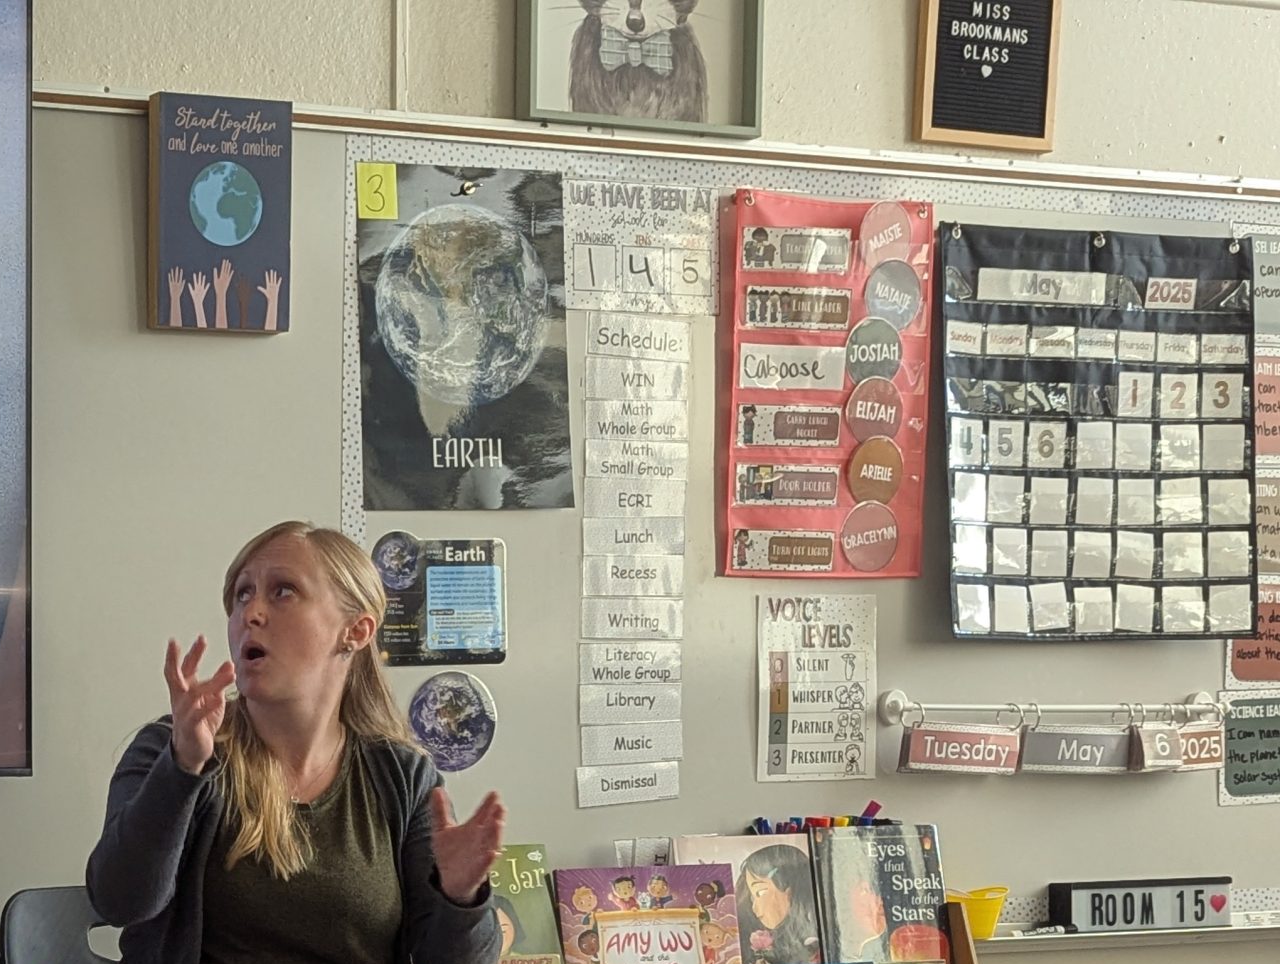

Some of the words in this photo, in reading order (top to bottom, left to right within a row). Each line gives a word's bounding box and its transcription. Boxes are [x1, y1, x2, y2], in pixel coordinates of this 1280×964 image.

[972, 1, 1011, 20] MISS
[951, 20, 1029, 45] BROOKMANS
[963, 44, 1009, 63] CLASS
[175, 106, 220, 130] Stand
[220, 110, 276, 141] together
[167, 132, 187, 151] and
[190, 132, 220, 155] love
[220, 140, 239, 155] one
[242, 137, 284, 158] another
[365, 173, 386, 213] 3
[569, 182, 596, 207] WE
[601, 183, 644, 210] HAVE
[650, 185, 688, 213] BEEN
[629, 253, 654, 287] 4
[682, 258, 699, 284] 5
[1021, 273, 1063, 300] May
[1148, 281, 1193, 303] 2025
[596, 327, 683, 353] Schedule:
[849, 342, 899, 363] JOSIAH
[744, 353, 825, 380] Caboose
[621, 372, 655, 388] WIN
[1258, 382, 1276, 395] can
[1131, 379, 1138, 407] 1
[1170, 381, 1186, 410] 2
[1213, 380, 1230, 408] 3
[621, 402, 653, 416] Math
[856, 400, 897, 424] ELIJAH
[598, 421, 637, 436] Whole
[640, 421, 676, 438] Group
[621, 442, 654, 456] Math
[959, 425, 973, 456] 4
[997, 428, 1013, 456] 5
[1037, 429, 1055, 458] 6
[432, 437, 503, 468] EARTH
[601, 461, 634, 474] Small
[637, 462, 674, 478] Group
[859, 464, 893, 481] ARIELLE
[618, 493, 653, 509] ECRI
[614, 528, 654, 545] Lunch
[843, 526, 897, 549] GRACELYNN
[445, 546, 486, 562] Earth
[772, 545, 791, 555] TURN
[792, 545, 805, 556] OFF
[807, 545, 829, 557] LIGHTS
[610, 565, 657, 580] Recess
[768, 597, 821, 623] VOICE
[608, 613, 660, 632] Writing
[801, 624, 853, 648] LEVELS
[605, 648, 656, 665] Literacy
[1236, 646, 1261, 660] about
[796, 657, 830, 672] SILENT
[592, 666, 631, 681] Whole
[635, 666, 671, 685] Group
[606, 692, 656, 710] Library
[792, 690, 833, 703] WHISPER
[1231, 705, 1264, 719] SCIENCE
[774, 720, 782, 735] 2
[791, 720, 834, 734] PARTNER
[1237, 730, 1255, 741] can
[614, 735, 653, 751] Music
[923, 736, 1010, 767] Tuesday
[1057, 739, 1105, 766] May
[1155, 733, 1170, 756] 6
[1180, 736, 1221, 759] 2025
[772, 749, 782, 767] 3
[791, 749, 844, 764] PRESENTER
[1228, 749, 1248, 764] the
[600, 773, 658, 792] Dismissal
[1233, 769, 1259, 786] solar
[867, 842, 906, 861] Eyes
[884, 860, 905, 873] that
[506, 858, 545, 895] Jar
[891, 873, 942, 895] Speak
[911, 895, 920, 905] to
[923, 893, 939, 905] the
[1091, 891, 1155, 926] ROOM
[1176, 889, 1205, 922] 15
[891, 906, 936, 922] Stars
[606, 931, 652, 955] AMY
[658, 930, 694, 953] WU
